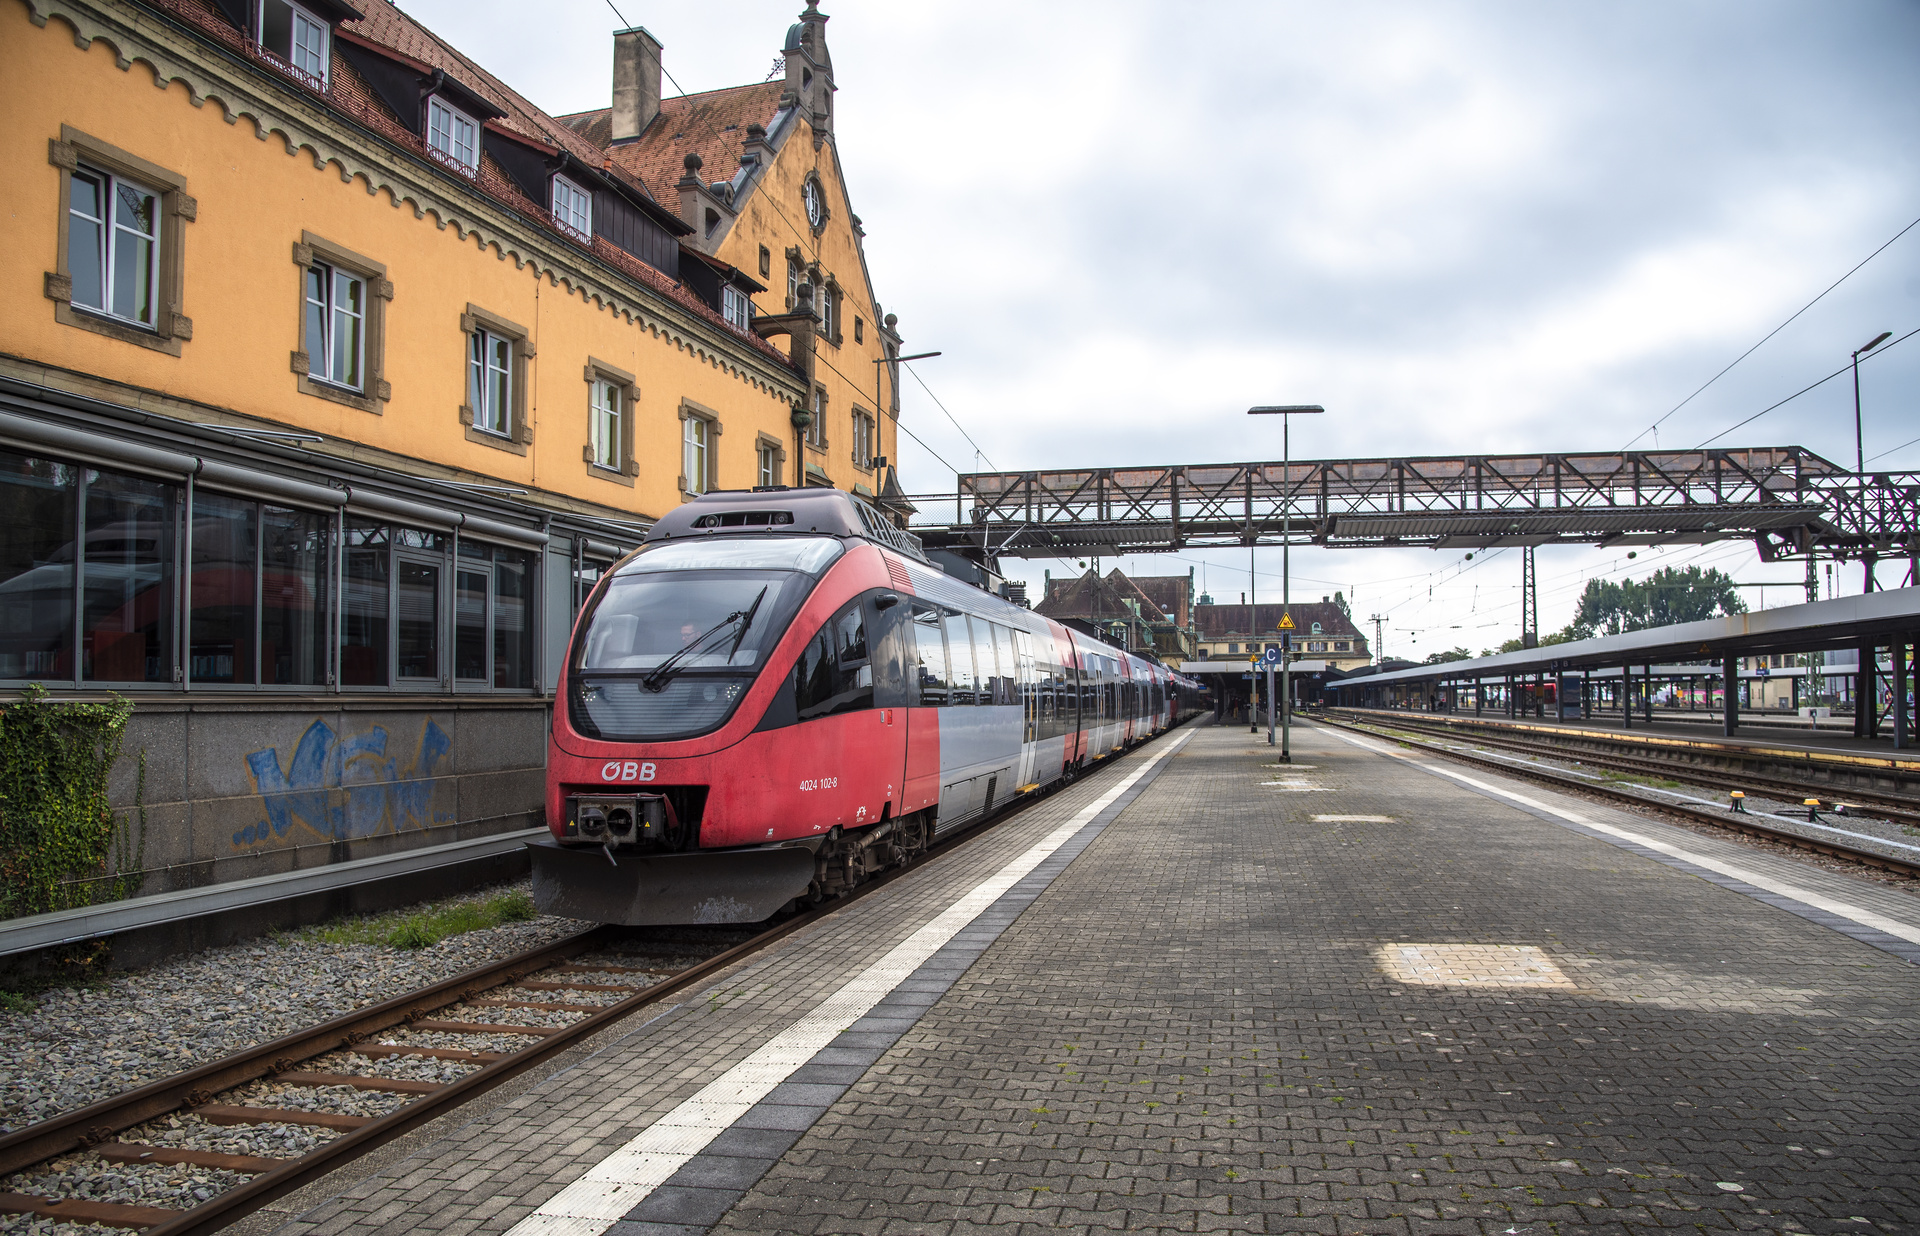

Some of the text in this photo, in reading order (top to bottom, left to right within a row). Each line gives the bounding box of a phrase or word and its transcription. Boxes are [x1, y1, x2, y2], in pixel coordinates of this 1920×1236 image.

[1266, 648, 1276, 661] C
[601, 761, 657, 781] ÖBB
[800, 777, 838, 791] 4024 102-8
